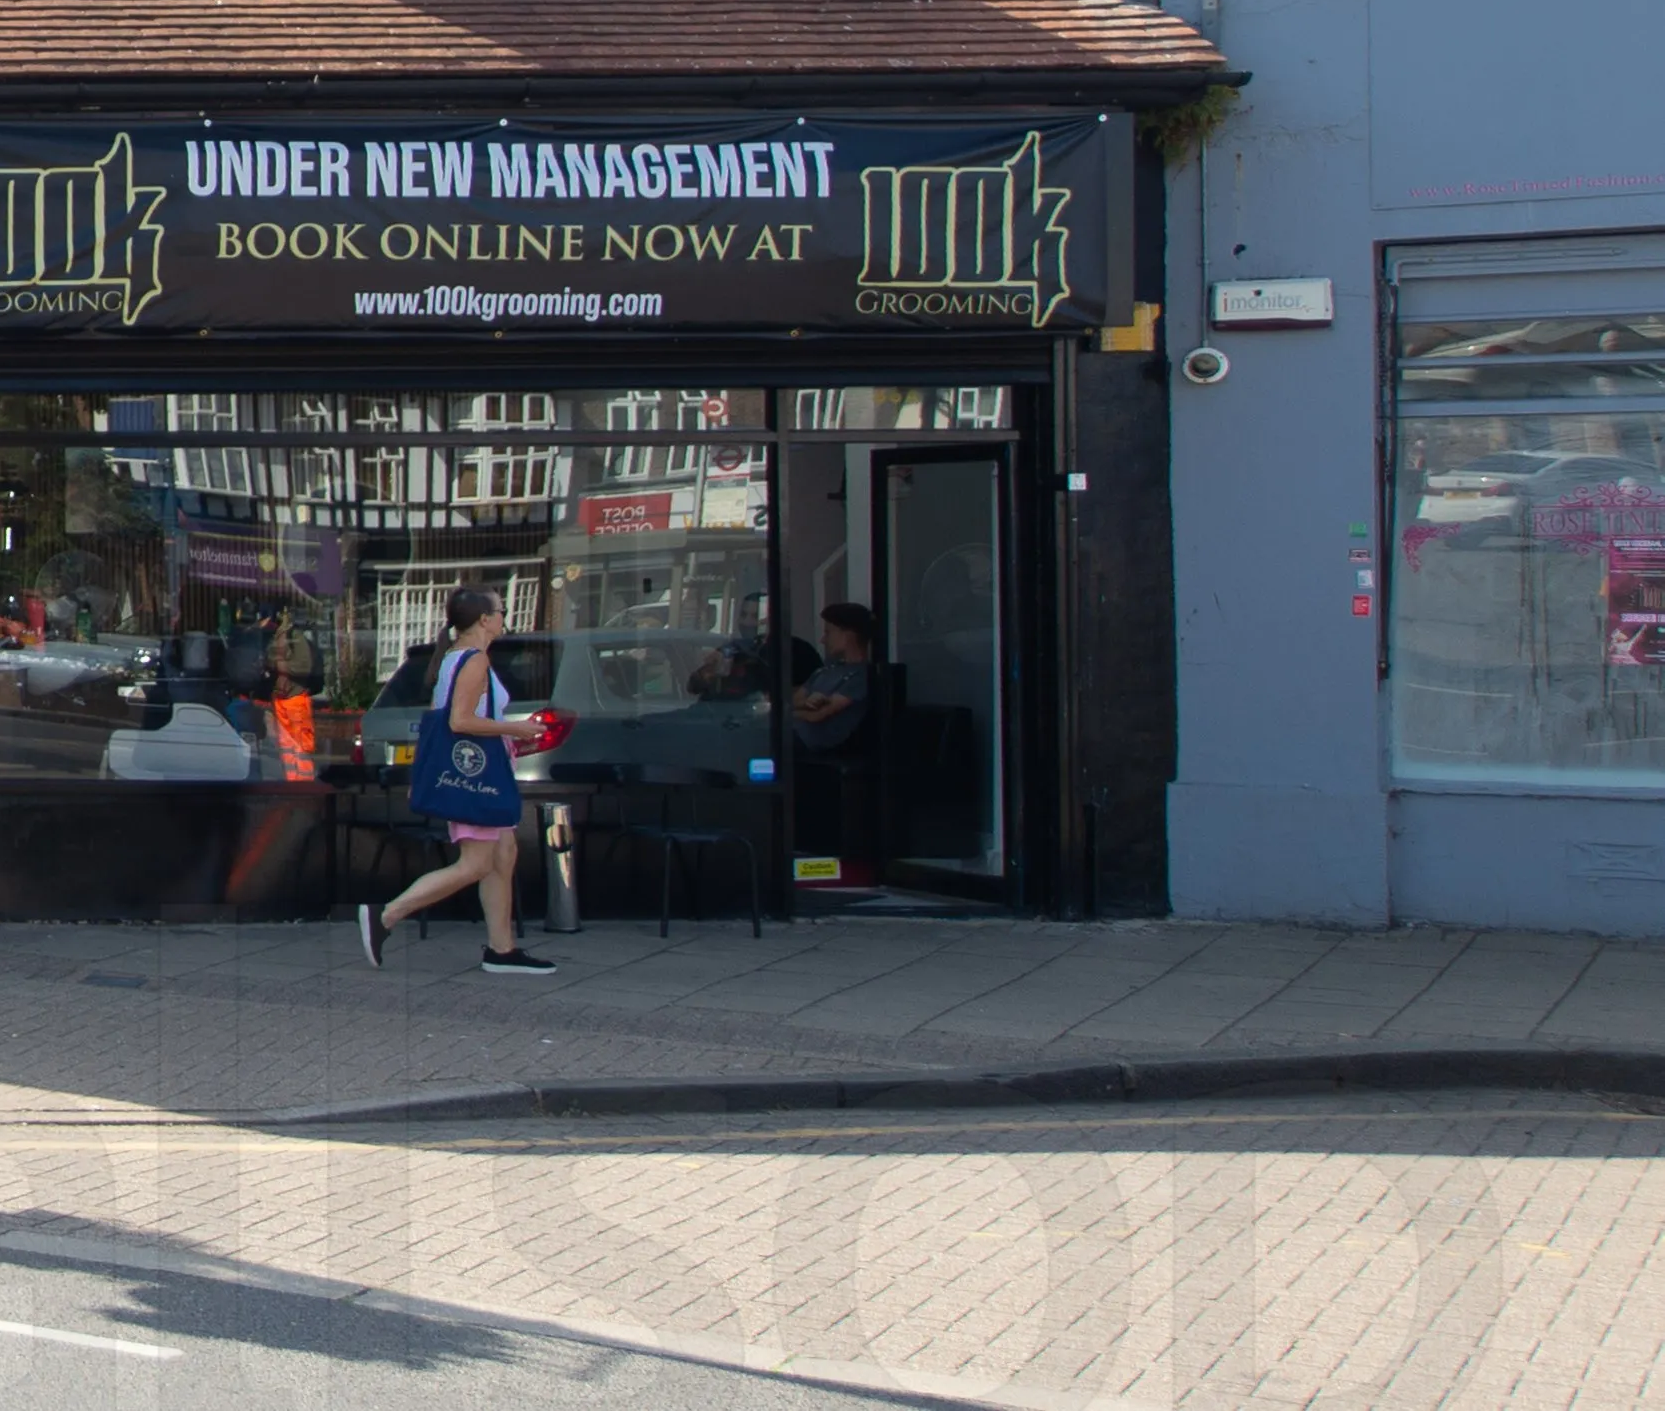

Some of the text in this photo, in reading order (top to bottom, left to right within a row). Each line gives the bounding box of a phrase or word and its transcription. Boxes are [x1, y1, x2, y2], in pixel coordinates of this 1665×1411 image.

[185, 140, 834, 199] UNDER NEW MANAGEMENT
[216, 222, 814, 262] BOOK ONLINE NOW AT
[354, 286, 662, 323] www.100kgrooming.com
[855, 289, 1033, 315] GROOMING
[1534, 511, 1593, 534] ROSE
